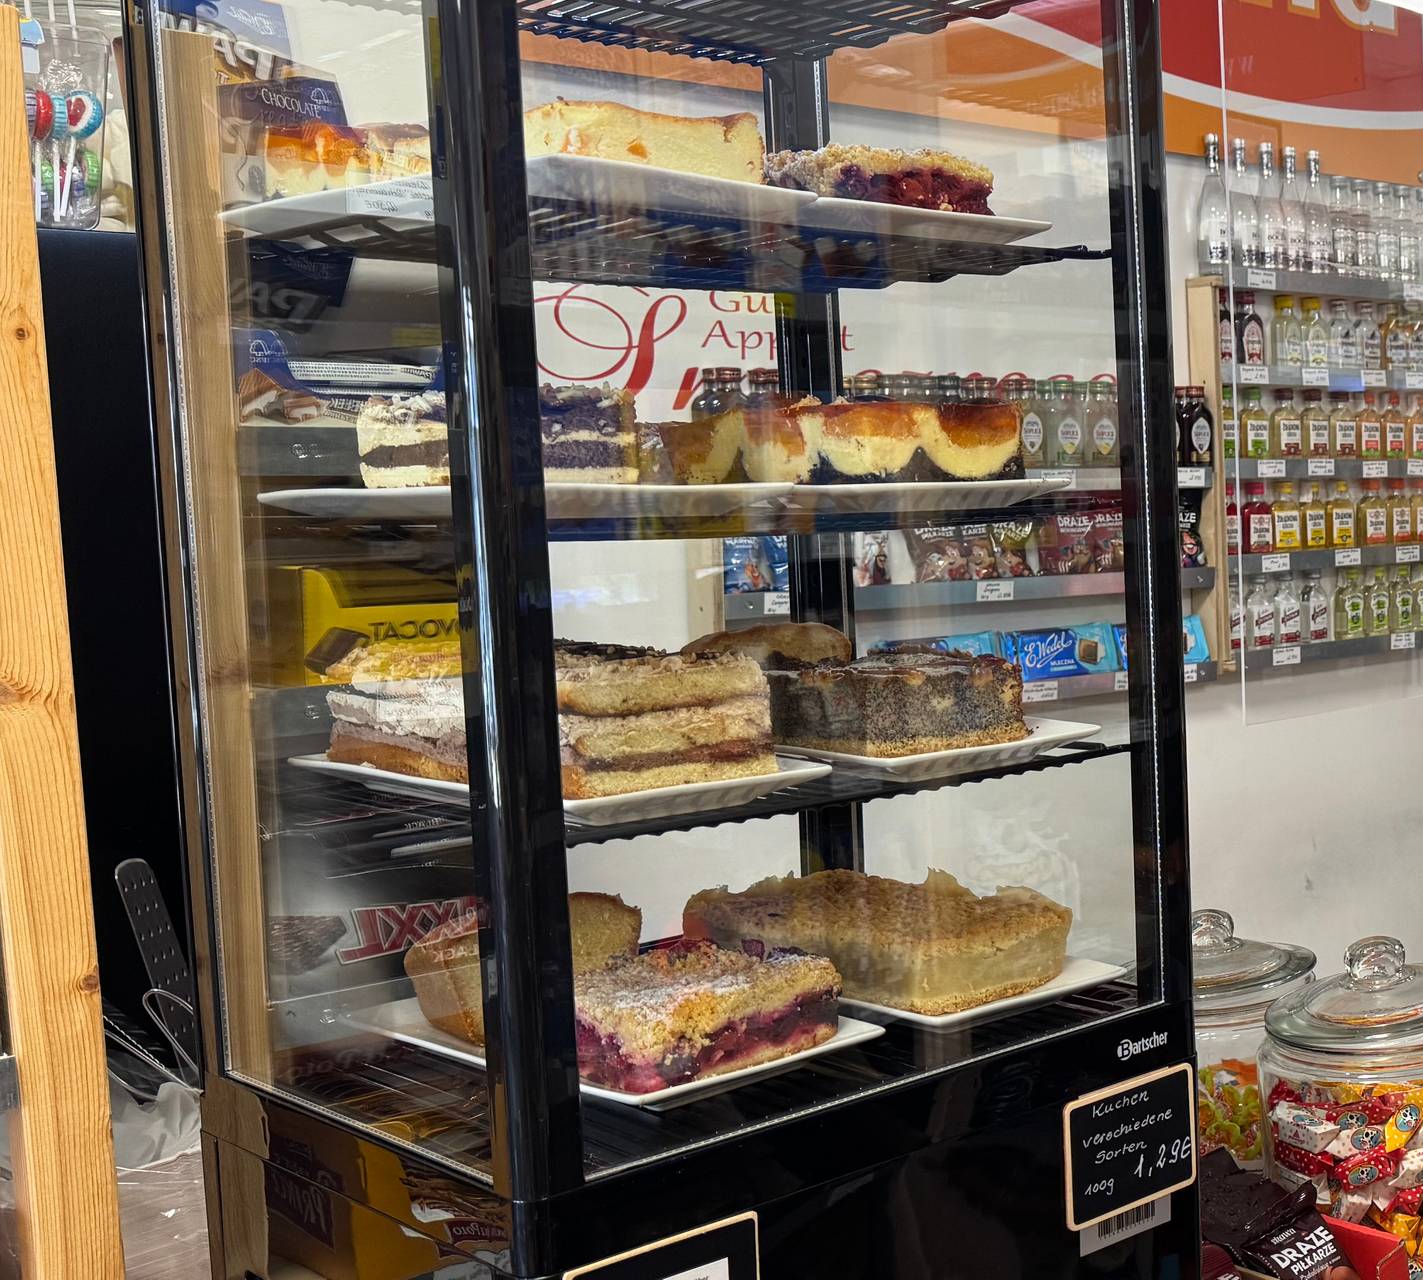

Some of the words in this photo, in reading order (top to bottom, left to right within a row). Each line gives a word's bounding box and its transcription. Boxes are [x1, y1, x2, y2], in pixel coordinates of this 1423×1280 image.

[261, 88, 321, 118] CHOCOLATE
[702, 320, 855, 360] Appt
[1117, 1031, 1168, 1061] Bartscher
[1092, 1089, 1149, 1119] Kuchen
[1083, 1107, 1173, 1149] verschiedene
[1084, 1178, 1115, 1196] 100g
[1133, 1136, 1191, 1178] 1,29€
[1094, 1140, 1148, 1165] Sorten
[1290, 1242, 1337, 1276] PIŁKARZE
